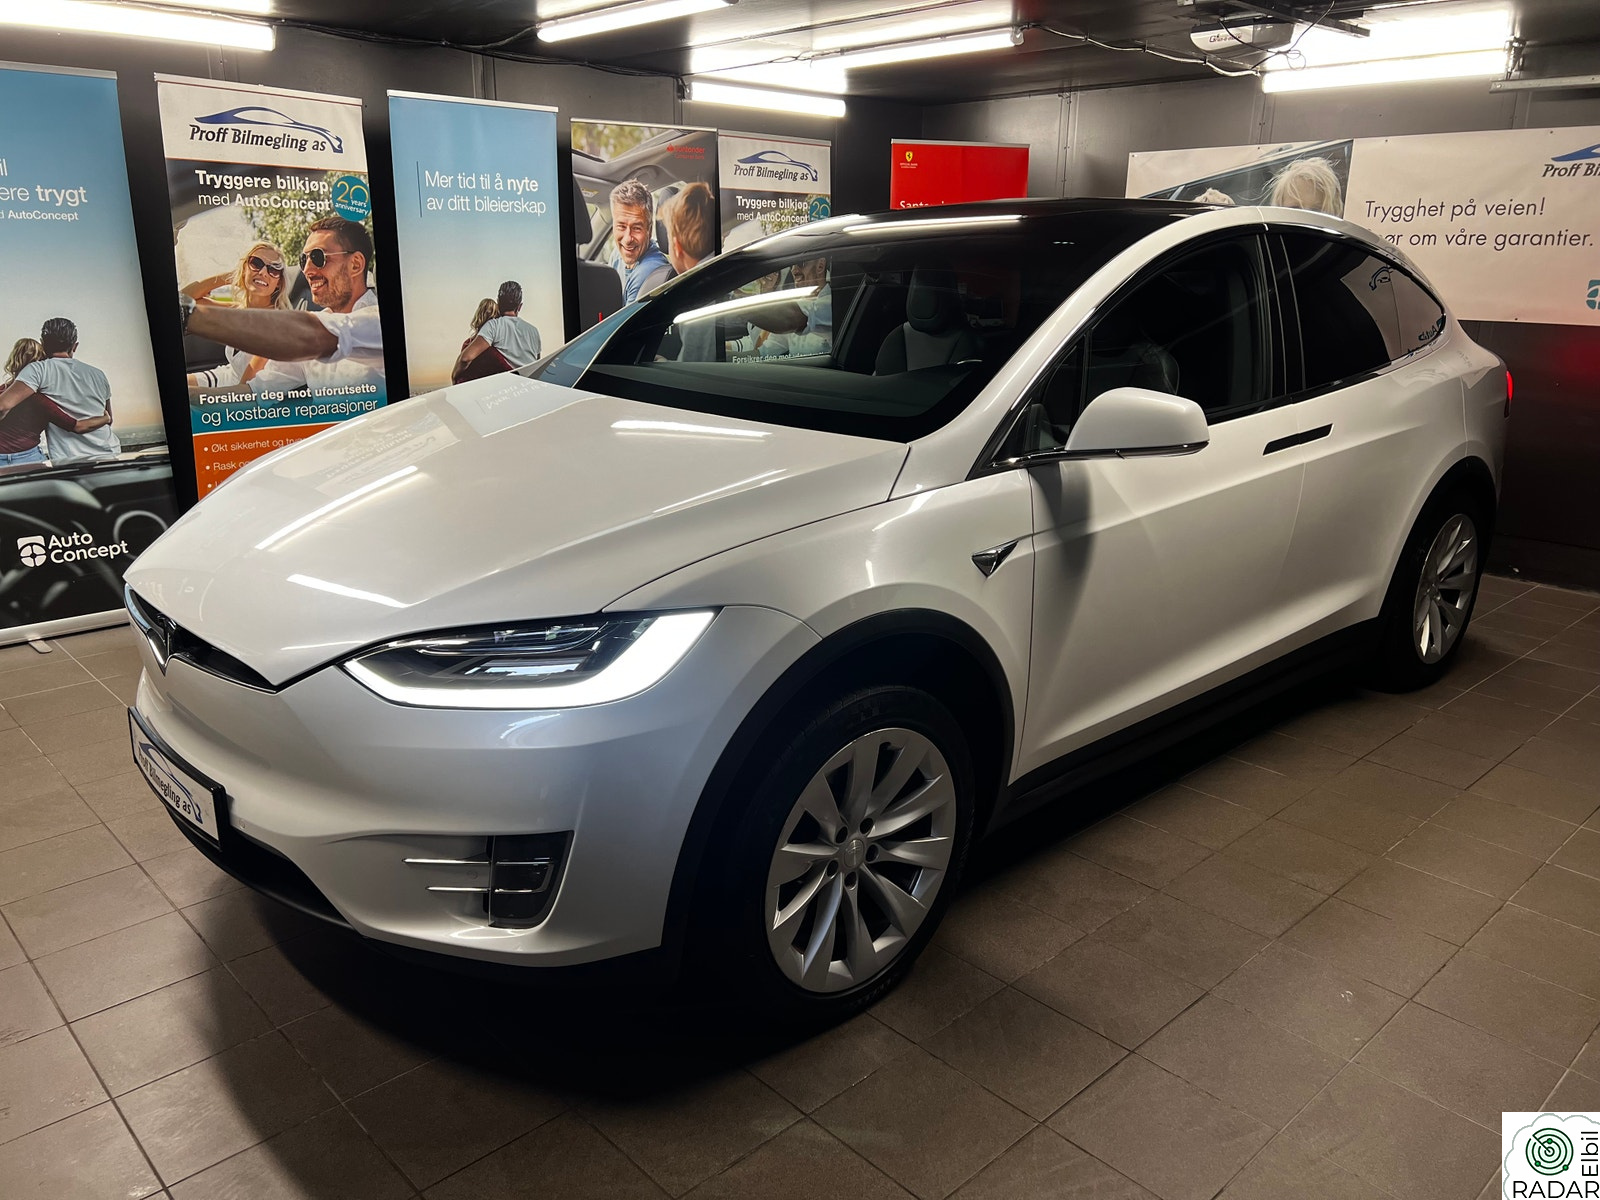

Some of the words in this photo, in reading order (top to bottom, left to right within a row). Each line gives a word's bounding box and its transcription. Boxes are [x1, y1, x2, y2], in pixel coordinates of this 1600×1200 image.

[189, 124, 228, 142] Proff
[231, 128, 308, 152] Bilmegling
[312, 140, 326, 152] as
[734, 164, 756, 176] Proff
[756, 166, 798, 181] Bilmegling
[1542, 162, 1582, 178] Proff
[194, 170, 272, 190] Tryggere
[276, 175, 329, 194] bilkjøp
[424, 170, 454, 188] Mer
[457, 172, 476, 189] tid
[480, 174, 490, 190] til
[494, 172, 504, 190] å
[507, 177, 538, 195] nyte
[36, 185, 88, 206] trygt
[198, 193, 230, 206] med
[234, 196, 331, 212] AutoConcept
[350, 200, 367, 208] years
[736, 196, 776, 209] Tryggere
[779, 198, 808, 212] bilkjøp
[335, 202, 368, 215] anniversary
[427, 197, 444, 210] av
[448, 195, 470, 212] ditt
[474, 196, 546, 216] bileierskap
[1365, 198, 1446, 222] Trygghet
[1450, 198, 1477, 222] på
[1484, 197, 1546, 216] veien!
[8, 209, 80, 222] AutoConcept
[736, 212, 754, 220] med
[756, 212, 808, 223] AutoConcept
[1409, 232, 1437, 246] om
[1445, 228, 1487, 246] våre
[1494, 230, 1594, 251] garantier.
[200, 390, 257, 405] Forsikrer
[261, 390, 284, 402] deg
[288, 387, 312, 398] mot
[315, 383, 377, 397] uforutsette
[202, 412, 222, 426] og
[226, 404, 290, 422] kostbare
[295, 399, 378, 418] reparasjoner
[211, 443, 228, 454] Økt
[231, 439, 270, 451] sikkerhet
[272, 439, 284, 448] og
[213, 462, 236, 472] Rask
[48, 532, 93, 550] Auto
[50, 540, 128, 564] Concept
[182, 800, 191, 814] as
